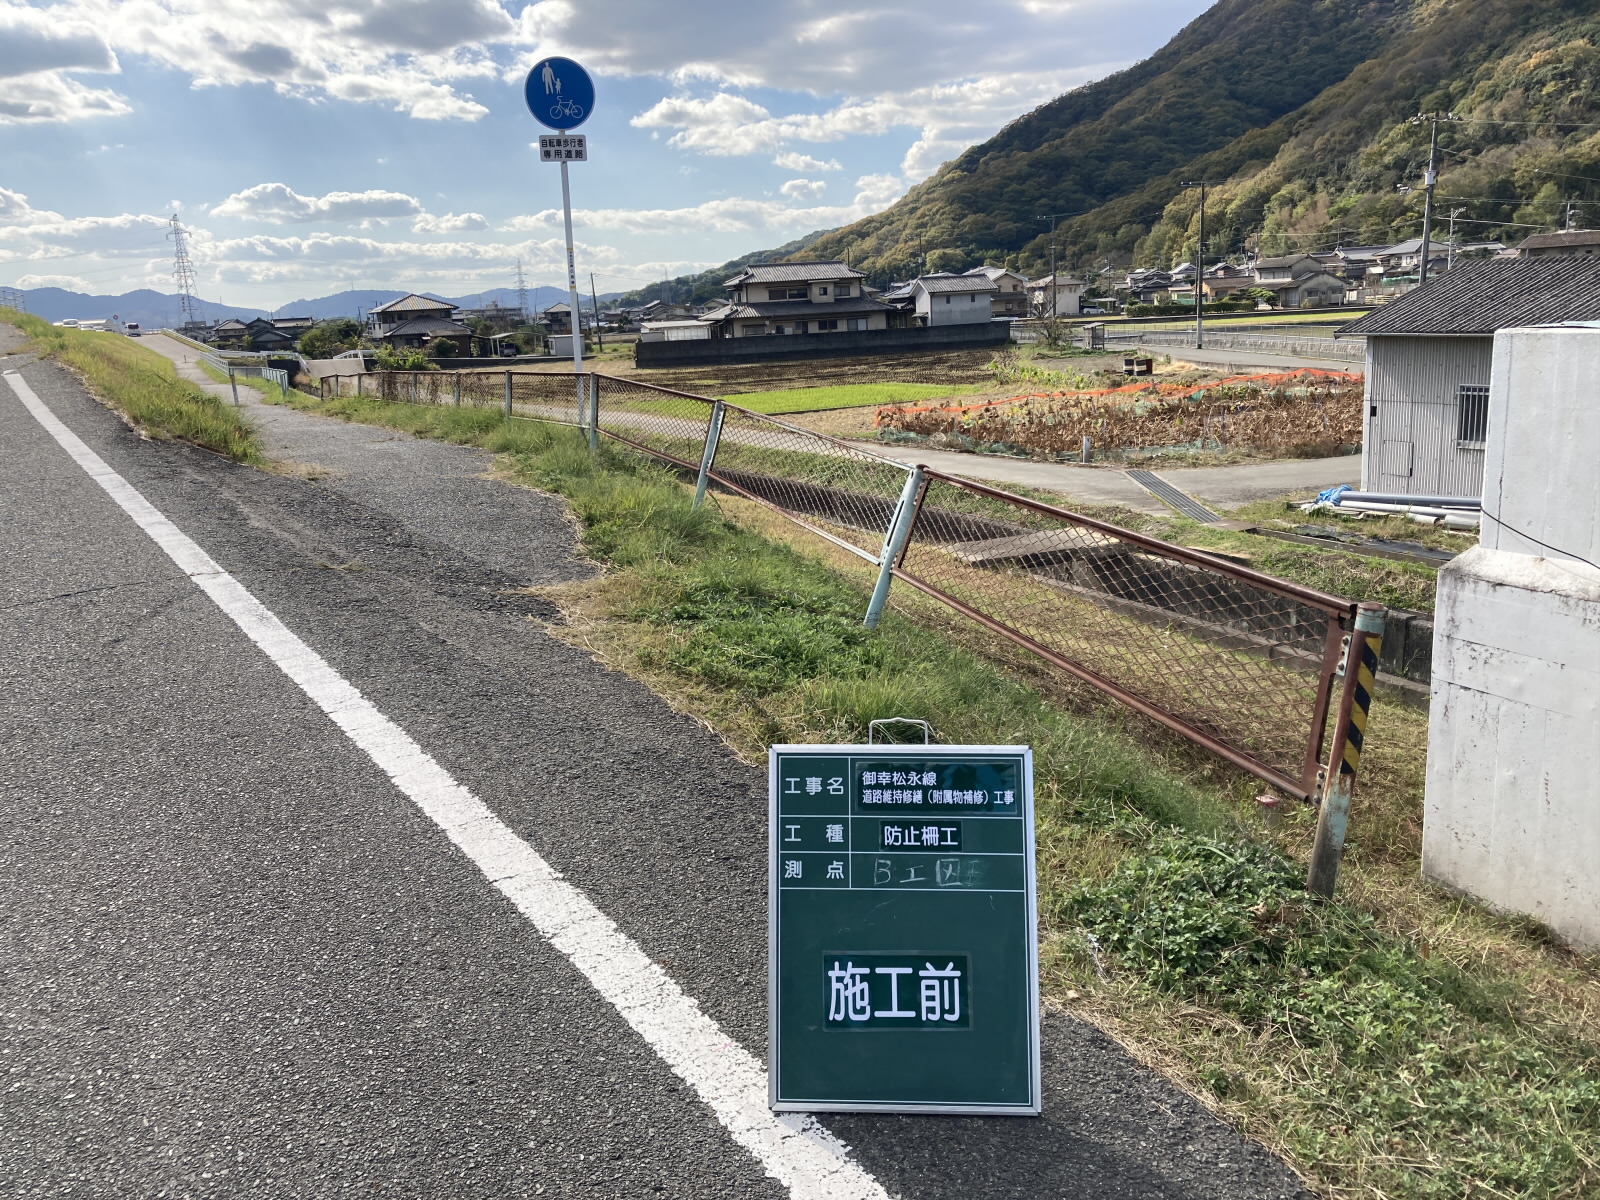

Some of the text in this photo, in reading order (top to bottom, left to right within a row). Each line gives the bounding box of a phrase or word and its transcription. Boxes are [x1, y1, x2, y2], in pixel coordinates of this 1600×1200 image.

[541, 138, 584, 148] 自転車歩行者
[544, 150, 583, 158] 専用道路
[784, 776, 844, 796] 工事名
[862, 771, 937, 786] 御幸松永線
[784, 824, 844, 843] 工種
[884, 825, 959, 846] 防止柵工
[784, 860, 844, 879] 測点
[828, 961, 962, 1021] 施工前
